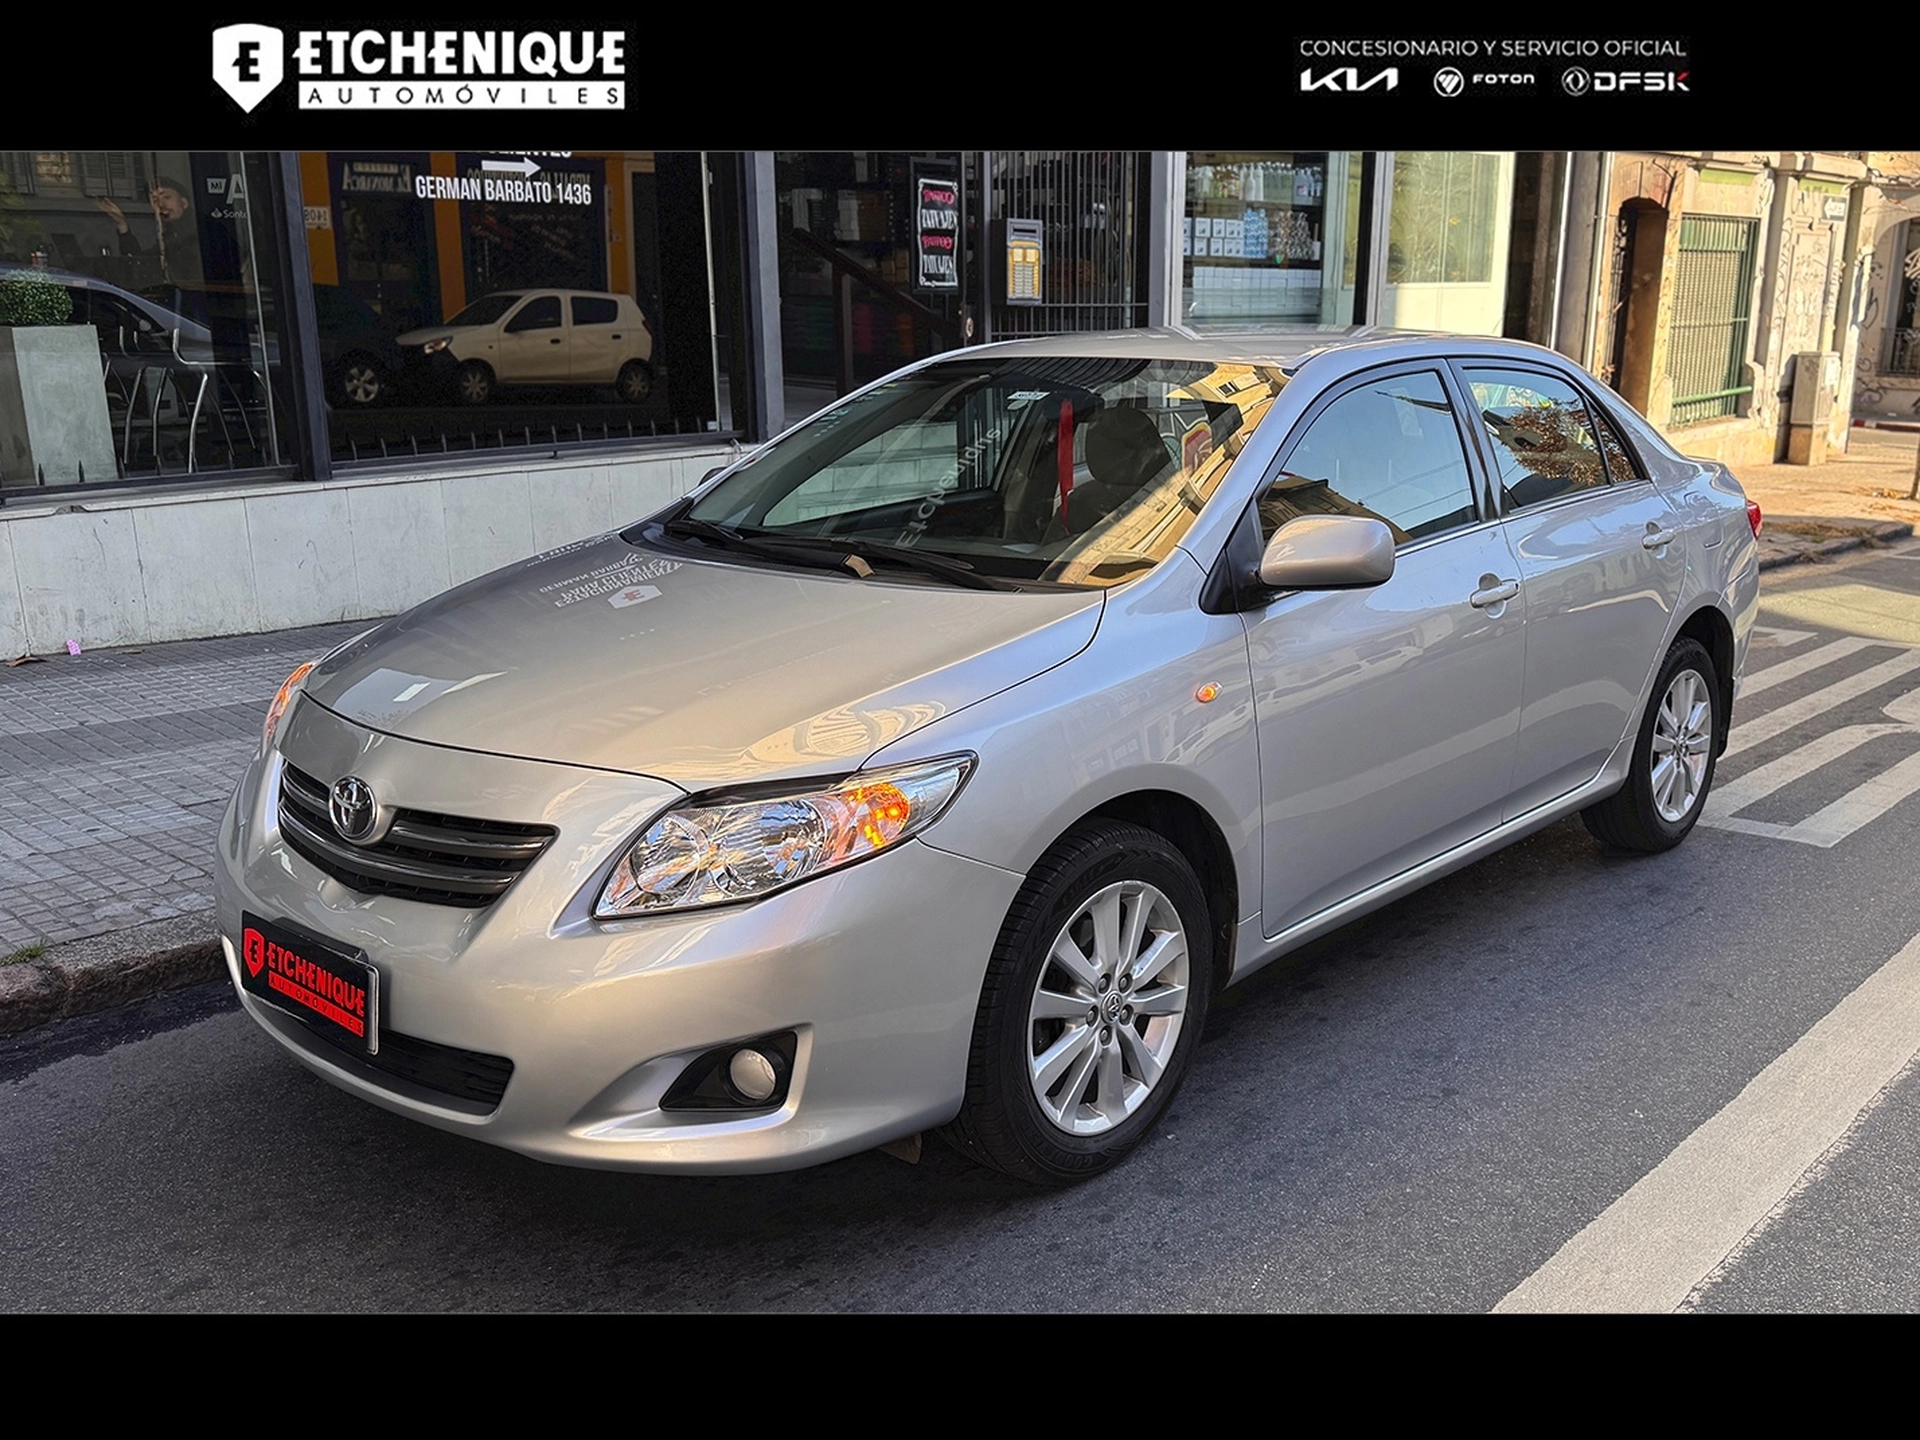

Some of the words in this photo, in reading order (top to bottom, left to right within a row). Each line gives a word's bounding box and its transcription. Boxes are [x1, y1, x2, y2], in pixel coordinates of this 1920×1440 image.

[415, 175, 482, 200] GERMAN
[485, 180, 551, 204] BARBATO
[556, 183, 592, 205] 1436
[267, 942, 365, 1017] ETCHENIQUE
